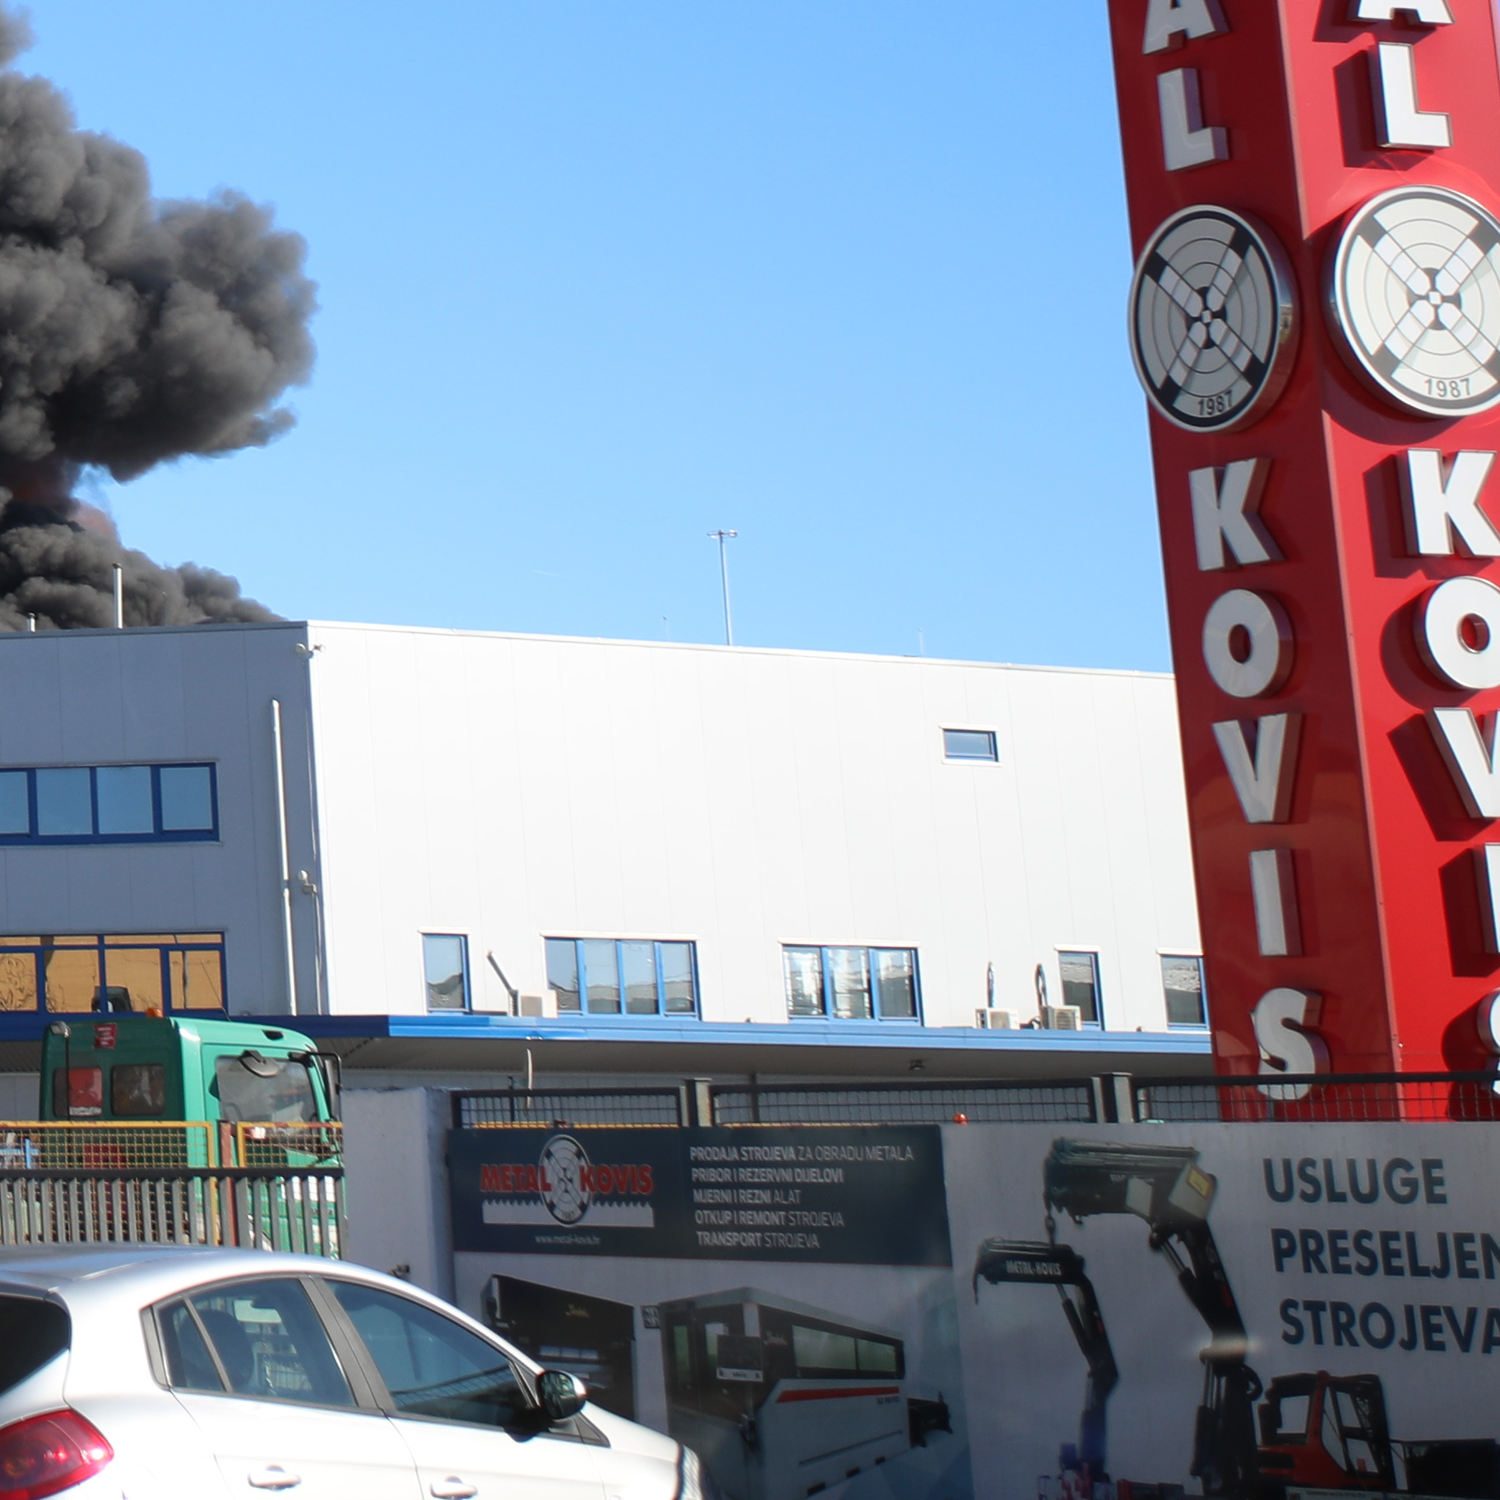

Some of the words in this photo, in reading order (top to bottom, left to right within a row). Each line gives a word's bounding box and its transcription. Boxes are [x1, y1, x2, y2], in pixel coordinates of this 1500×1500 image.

[1424, 378, 1472, 399] 1987
[1197, 389, 1234, 417] 1987
[1189, 457, 1329, 1102] KOVIS
[690, 1146, 739, 1162] PRODAJA
[741, 1146, 796, 1162] STROJEVA
[797, 1146, 814, 1161] ZA
[815, 1146, 863, 1161] OBRADU
[866, 1146, 915, 1162] METALA
[480, 1164, 552, 1193] METAL
[578, 1163, 655, 1195] KOVIS
[691, 1167, 732, 1183] PRIBOR
[739, 1168, 793, 1183] REZERVNI
[794, 1168, 845, 1183] DIJELOVI
[1263, 1156, 1448, 1205] USLUGE
[739, 1189, 773, 1204] REZNI
[694, 1210, 732, 1225] OTKUP
[739, 1210, 787, 1226] REMONT
[788, 1211, 846, 1227] STROJEVA
[696, 1231, 764, 1247] TRANSPORT
[765, 1232, 821, 1249] STROJEVA
